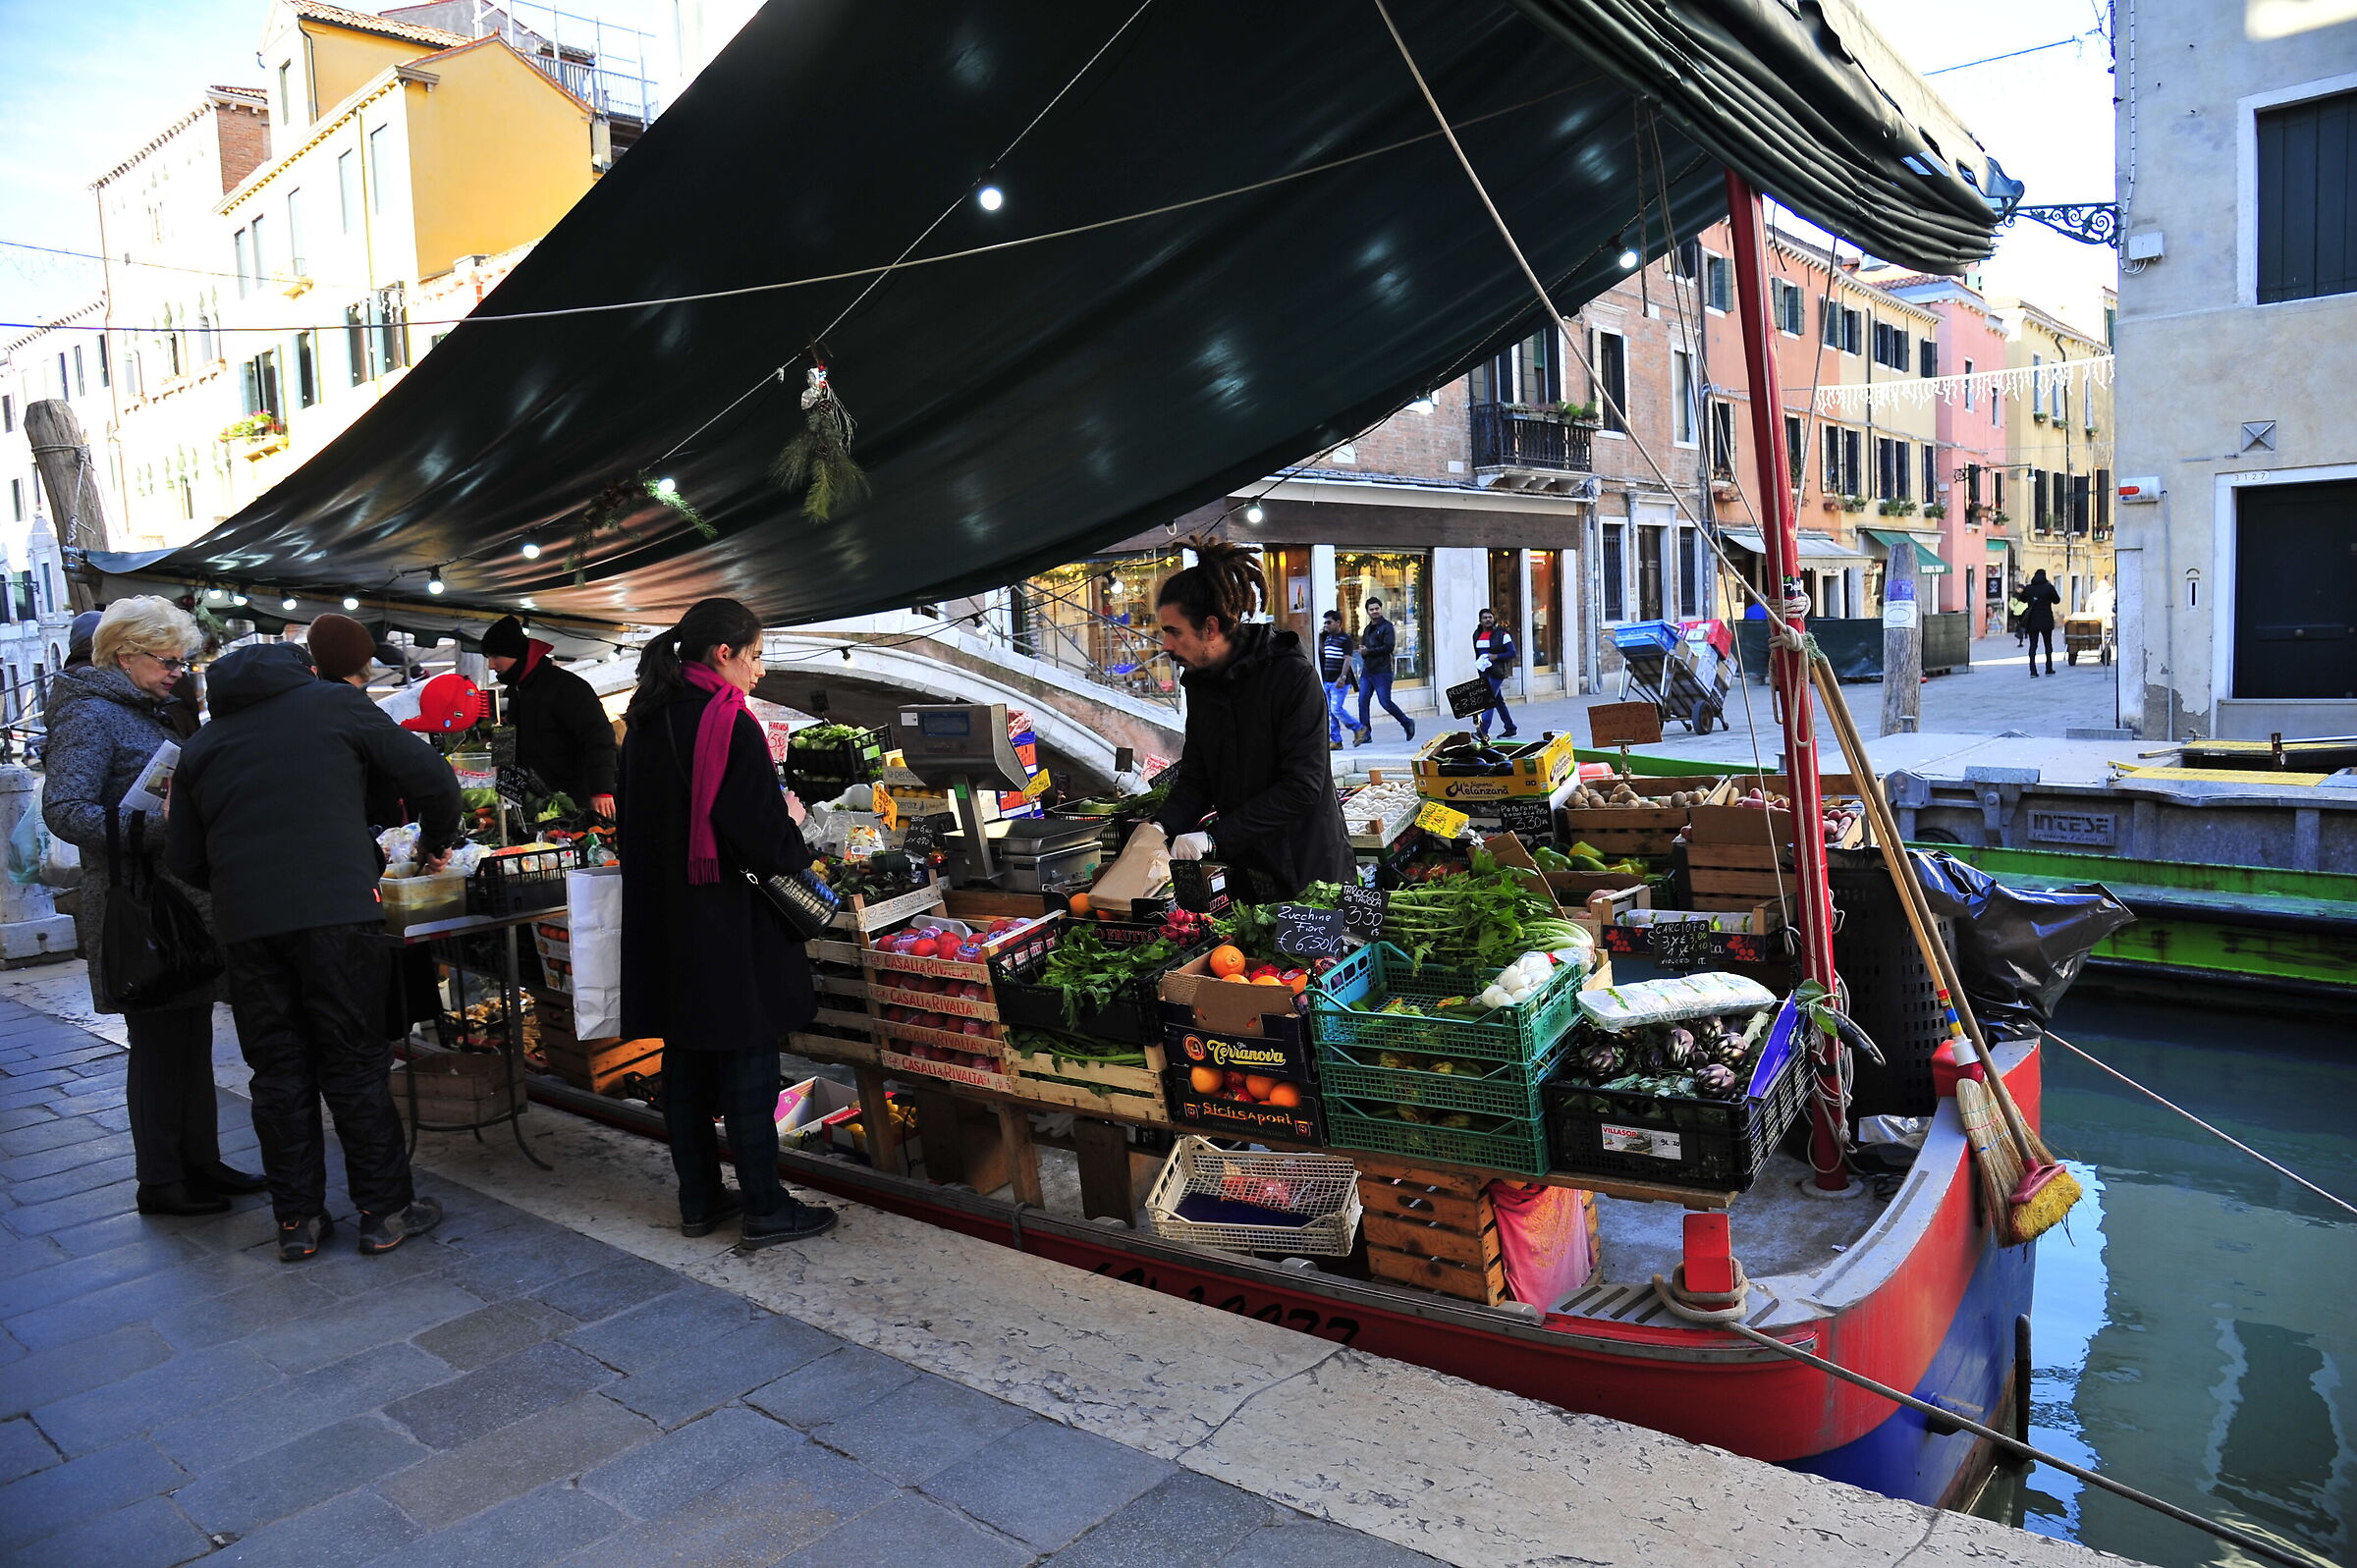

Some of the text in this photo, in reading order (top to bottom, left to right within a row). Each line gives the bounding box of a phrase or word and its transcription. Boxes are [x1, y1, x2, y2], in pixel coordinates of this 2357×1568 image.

[1446, 783, 1510, 798] Melanzana
[1277, 905, 1332, 922] Zucchine
[1655, 923, 1706, 935] CARCIOFO
[1207, 1040, 1286, 1066] Terranova
